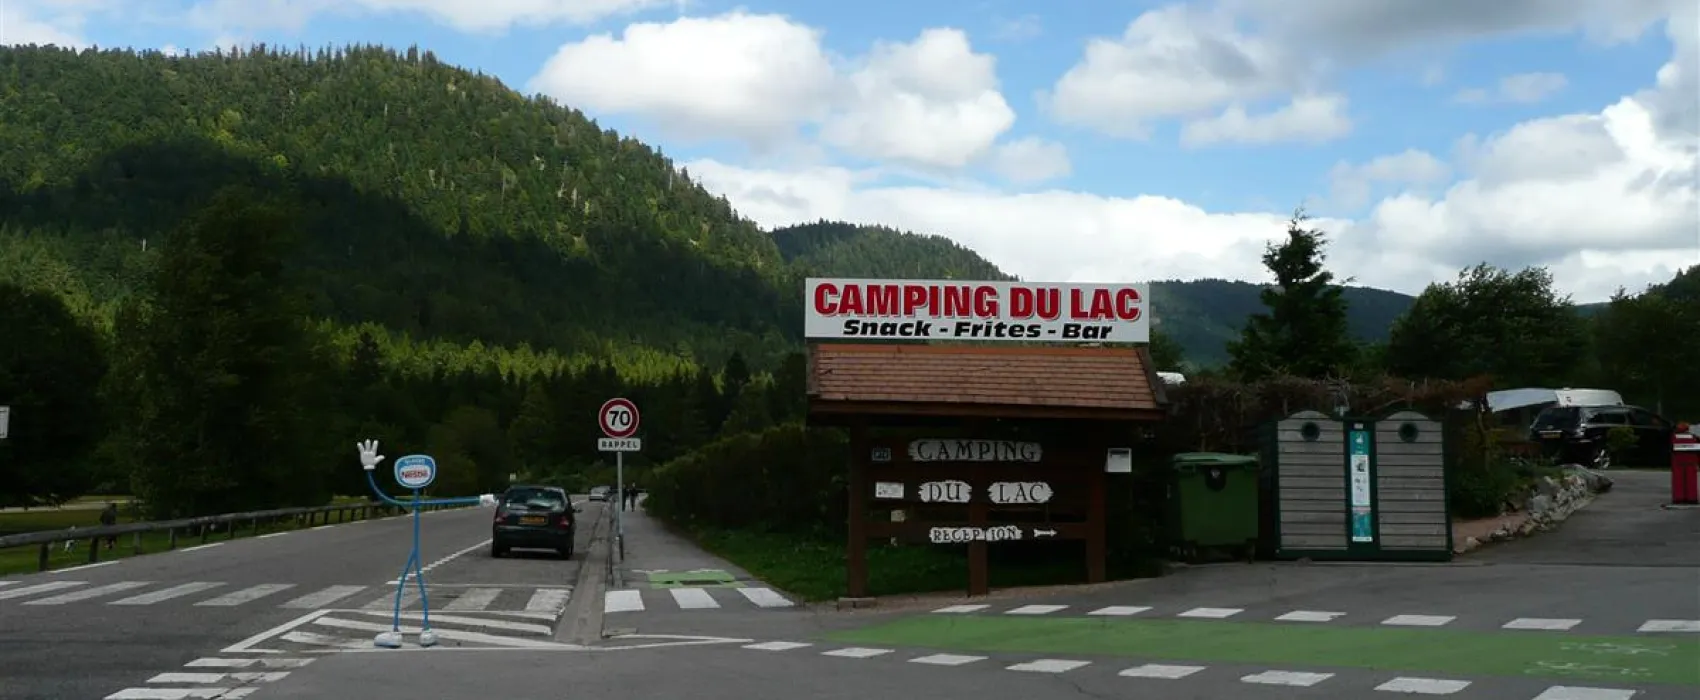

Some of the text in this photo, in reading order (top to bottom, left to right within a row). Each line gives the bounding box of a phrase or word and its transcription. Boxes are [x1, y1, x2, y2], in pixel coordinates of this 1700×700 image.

[813, 283, 1141, 321] CAMPING DU LAC
[843, 319, 931, 337] Snack
[954, 320, 1041, 338] Frites
[1062, 322, 1113, 339] Bar
[609, 410, 631, 426] 70
[601, 440, 638, 449] RAPPEL
[917, 440, 1036, 460] CAMPING
[928, 482, 1045, 503] DU LAC
